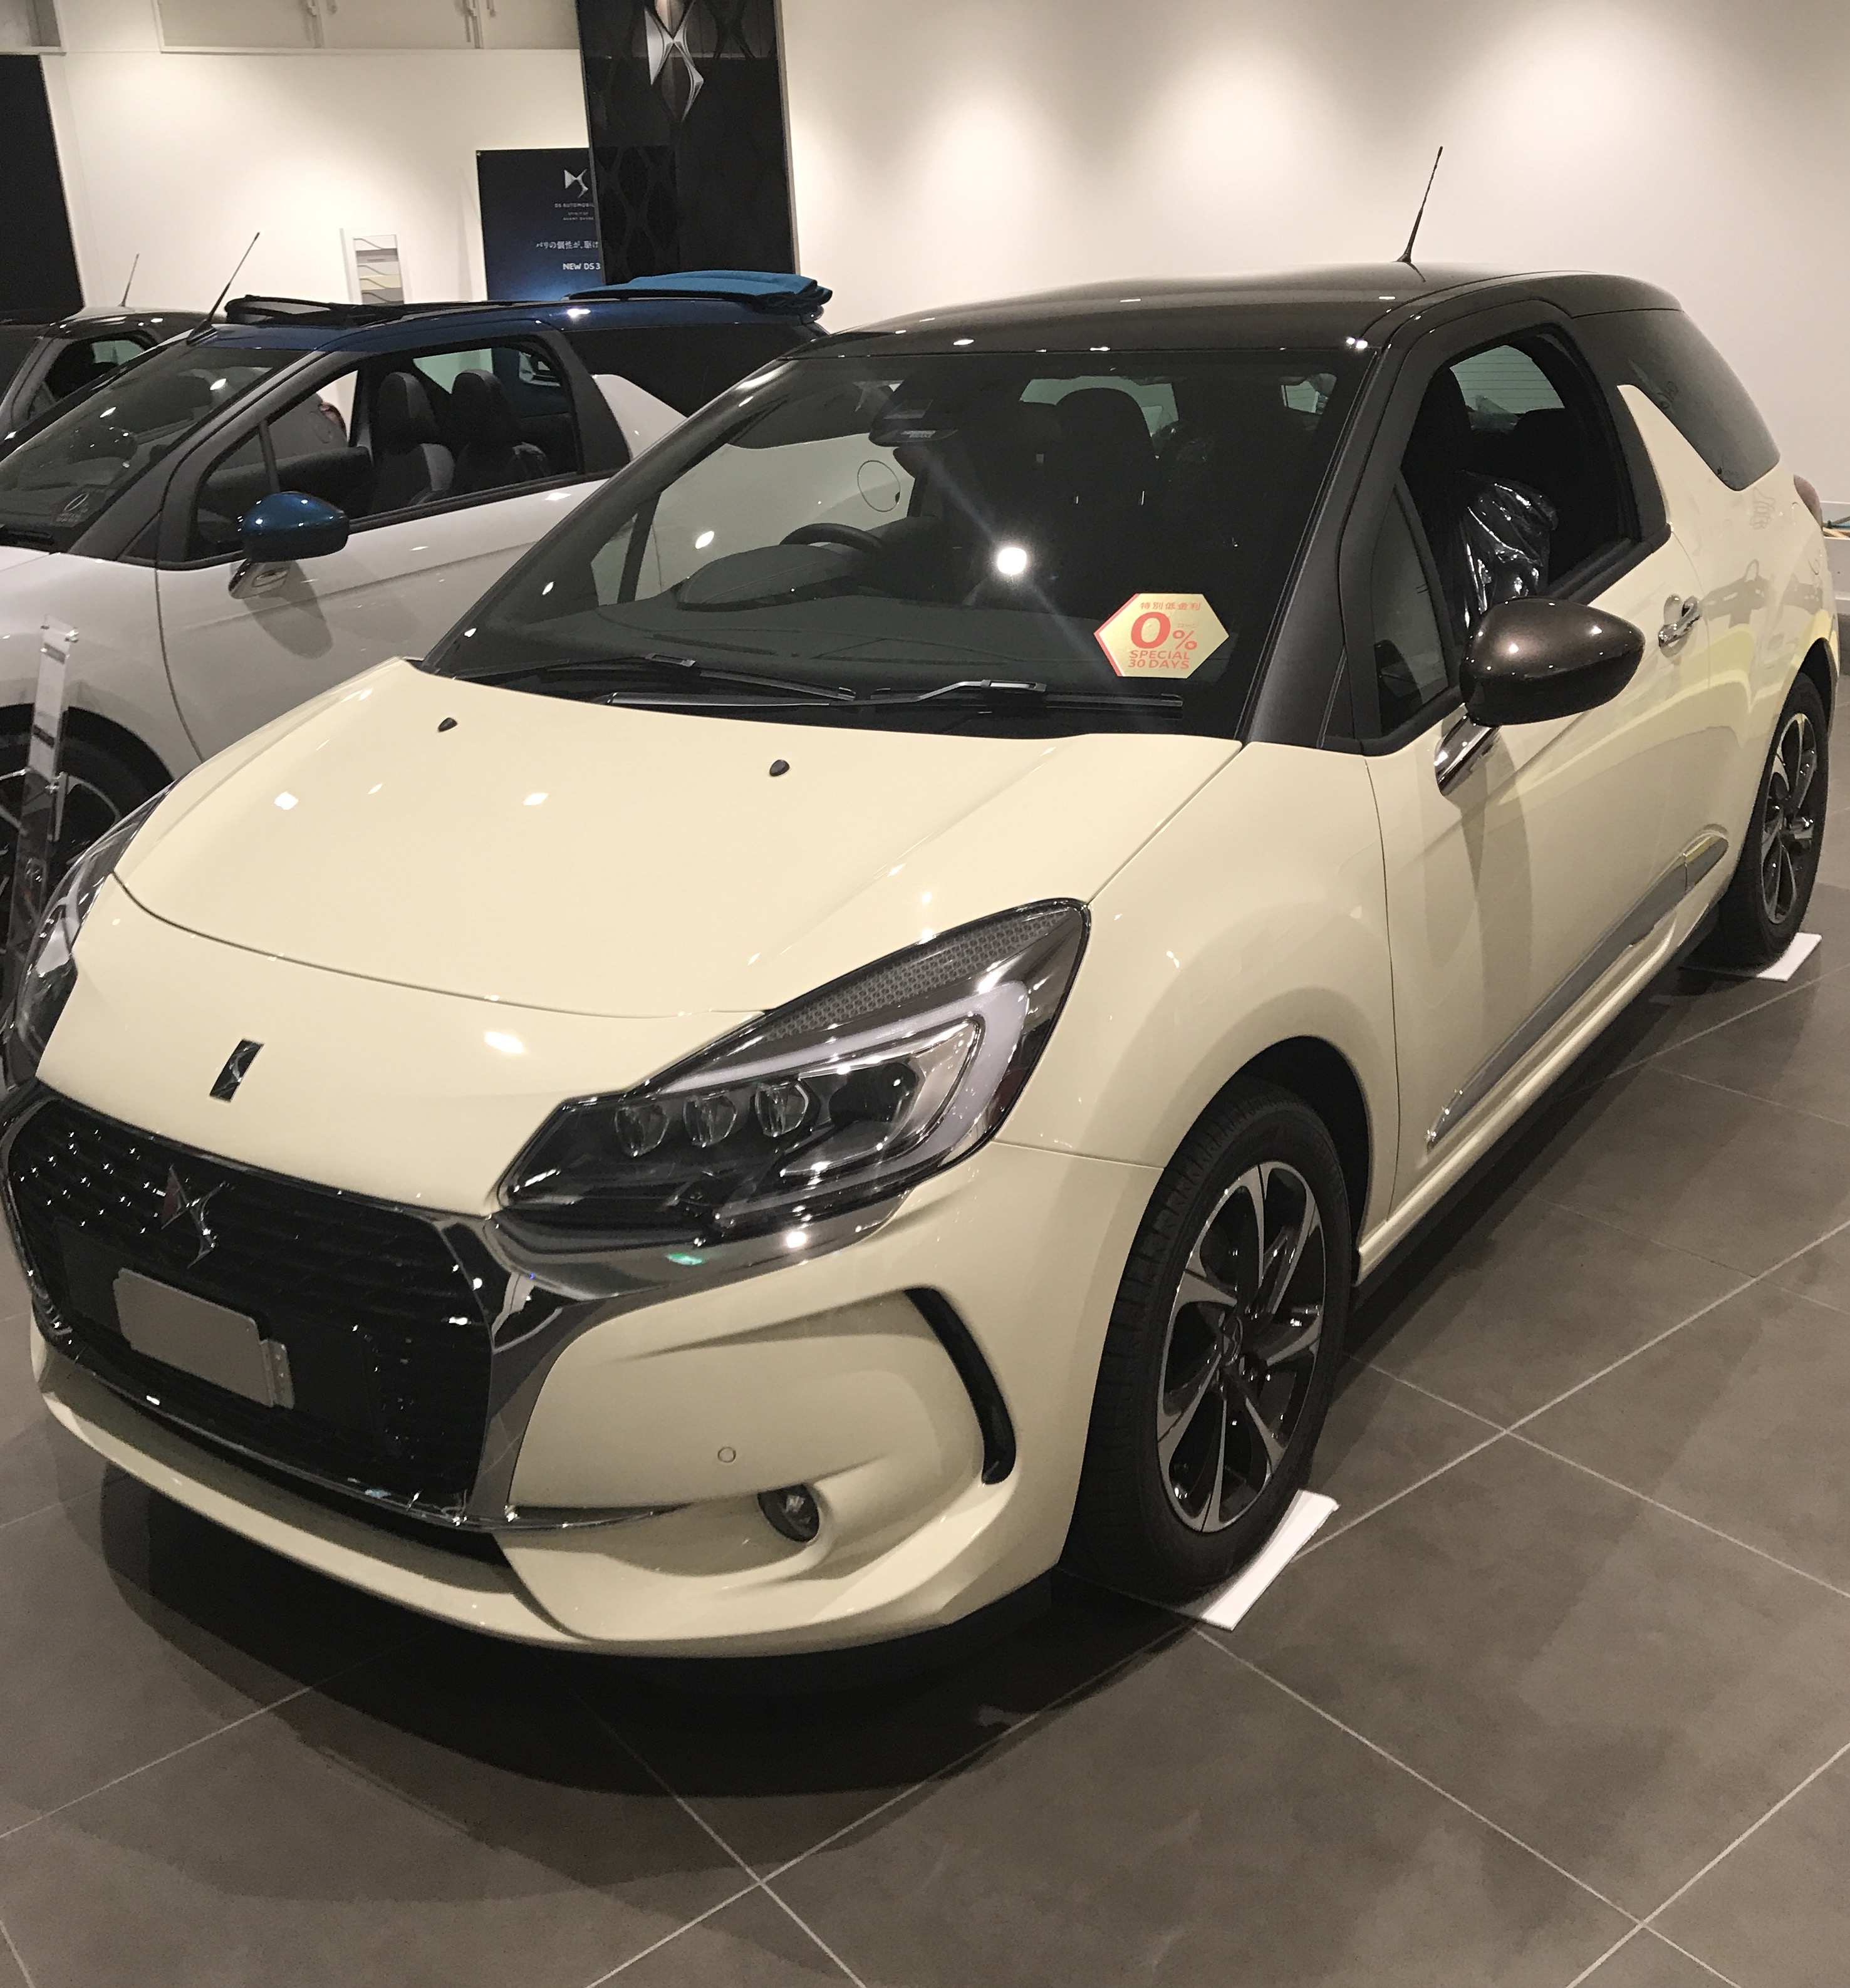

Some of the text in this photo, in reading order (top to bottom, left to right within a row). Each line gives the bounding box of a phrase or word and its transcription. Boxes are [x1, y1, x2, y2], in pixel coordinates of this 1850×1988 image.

[1140, 602, 1201, 611] 特別低金利
[1130, 650, 1190, 660] SPECIAL
[1128, 659, 1189, 669] 30 DAYS
